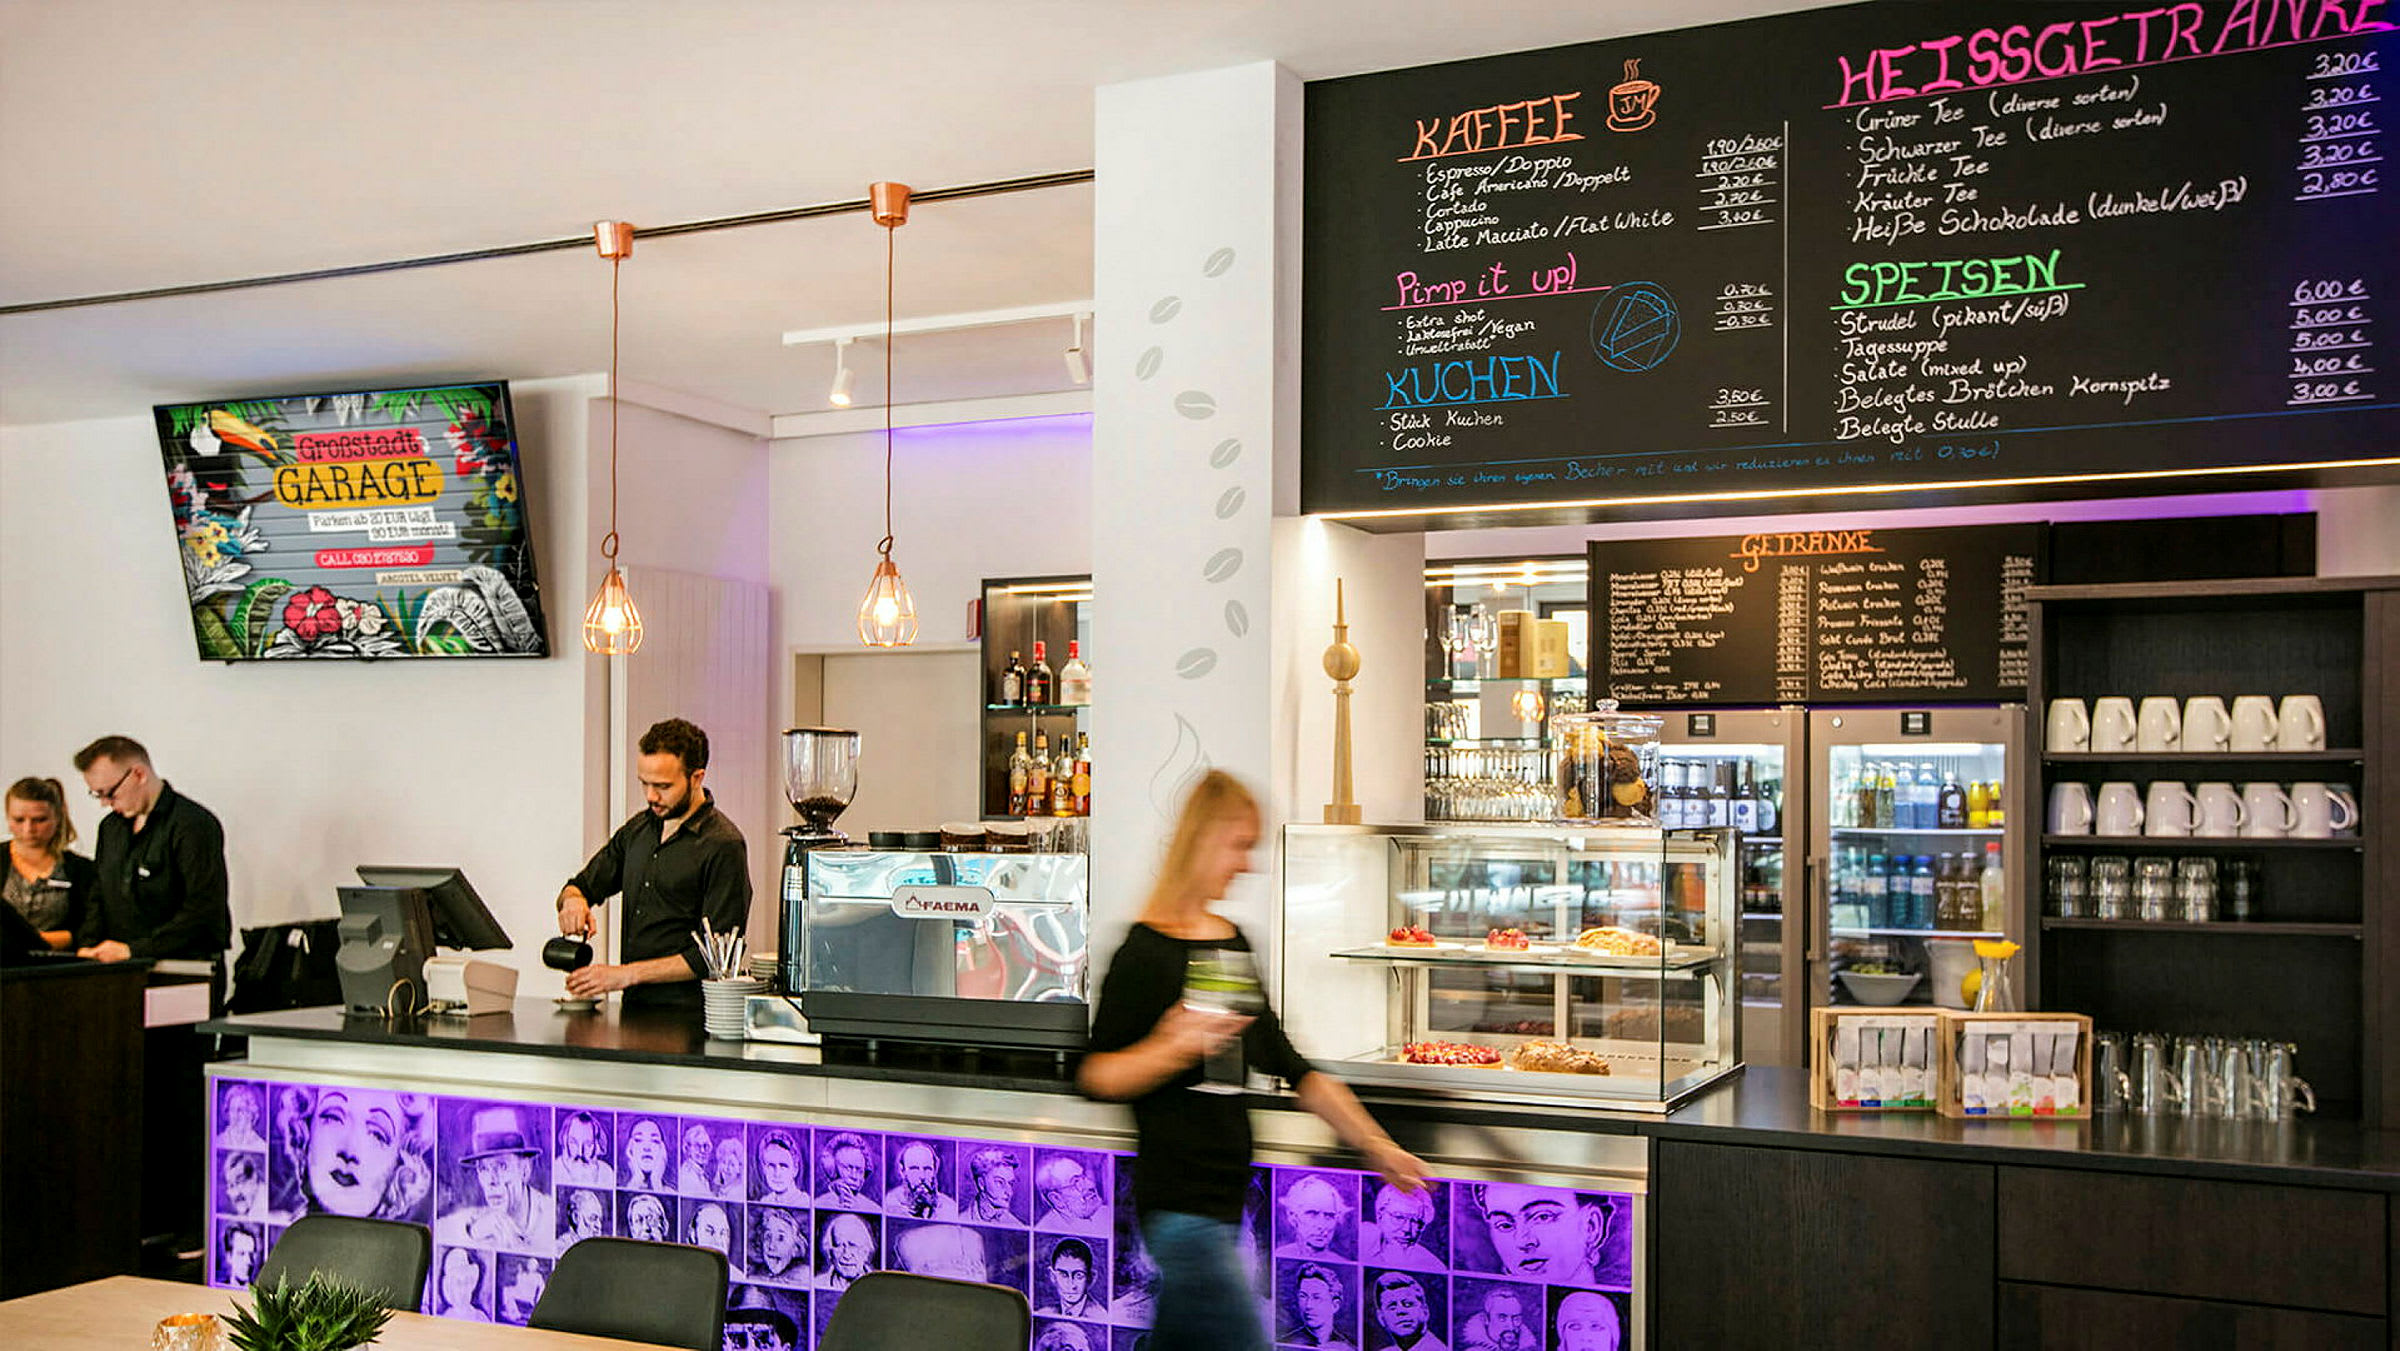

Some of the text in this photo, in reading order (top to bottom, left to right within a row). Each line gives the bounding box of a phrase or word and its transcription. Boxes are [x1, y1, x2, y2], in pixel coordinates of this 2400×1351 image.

[1413, 92, 1585, 157] KAFFEE
[1856, 108, 1921, 132] Grüner
[1929, 98, 1964, 126] Tee
[1859, 136, 1961, 164] Schwarzer
[1971, 125, 2007, 149] Tee
[1474, 177, 1548, 195] Americano
[1857, 155, 1990, 188] Früchte Tee
[1427, 199, 1487, 218] Cortado
[1854, 183, 1978, 213] Kräuter Tee
[1425, 215, 1499, 236] Cappucino
[1425, 235, 1469, 253] Latte
[1476, 222, 1548, 245] Macciato
[1615, 209, 1674, 229] White
[1852, 212, 1926, 246] Heiße
[1938, 204, 2081, 235] Schokolade
[1397, 271, 1466, 306] Pimp
[1478, 262, 1509, 296] it
[1841, 249, 2060, 305] SPEISEN
[1407, 309, 1485, 329] Extra shot
[1840, 310, 1916, 335] Strudel
[1841, 337, 1948, 363] Tagessuppe
[1385, 351, 1561, 407] KUCHEN
[1840, 364, 1908, 385] Salate
[1837, 372, 2171, 413] Belegtes Brötchen Kornspitz
[1390, 410, 1503, 430] Stück Kuchen
[1837, 411, 1999, 444] Belegte Stulle
[1393, 432, 1451, 450] Cookie
[278, 460, 437, 505] GARAGE
[320, 552, 352, 565] CALL
[921, 901, 981, 913] FAEMA
